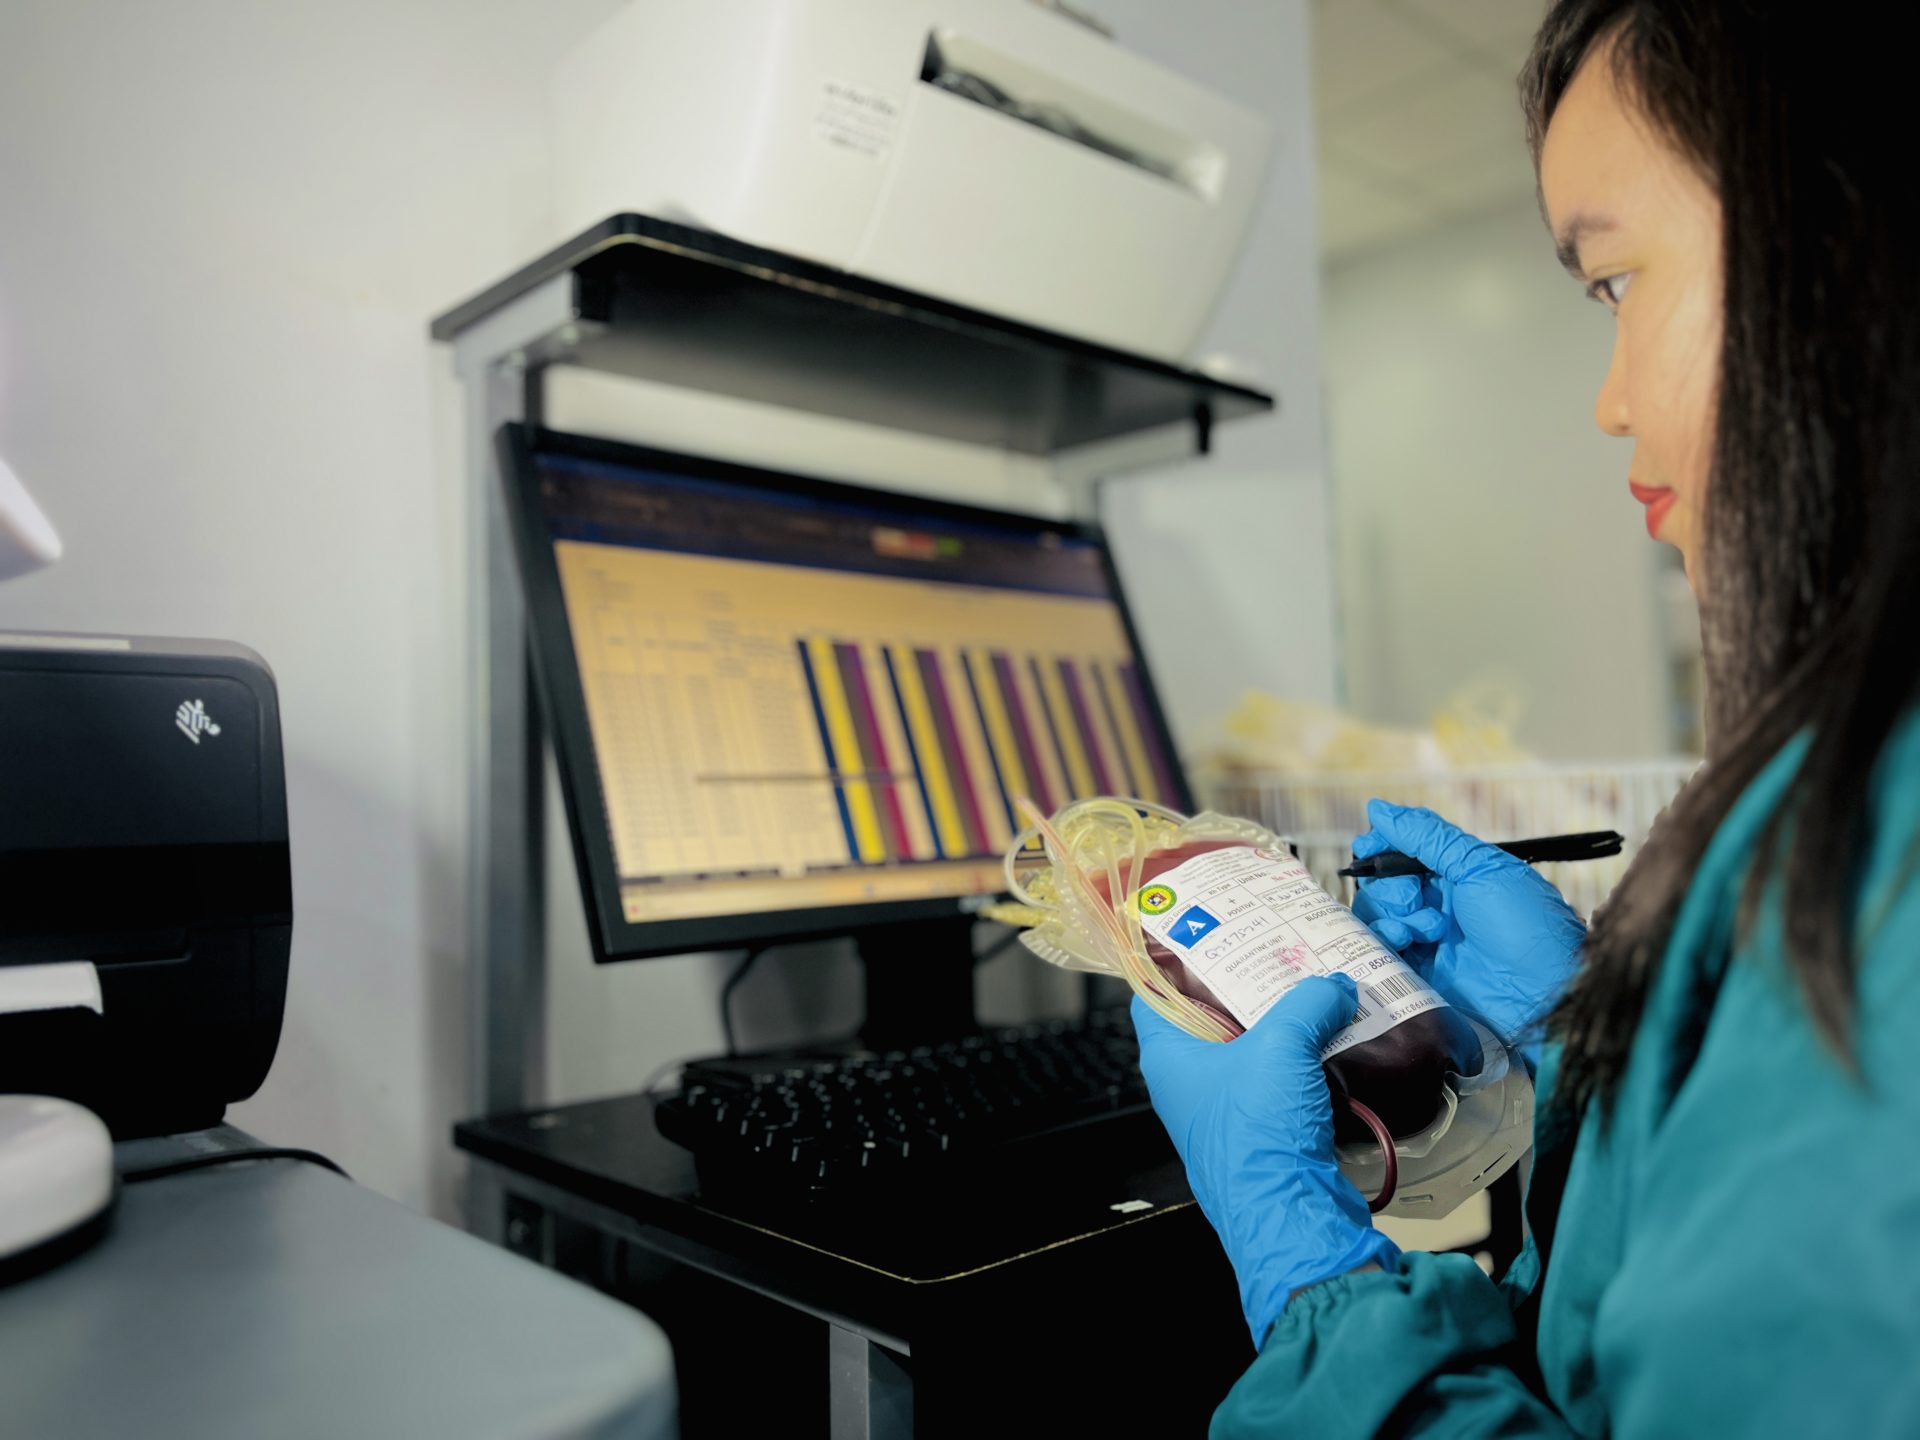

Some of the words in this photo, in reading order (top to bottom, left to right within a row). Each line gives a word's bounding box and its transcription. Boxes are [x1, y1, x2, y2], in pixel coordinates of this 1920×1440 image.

[1239, 874, 1254, 885] Unit
[1173, 903, 1192, 919] Group
[1226, 900, 1256, 918] POSITIVE
[1304, 910, 1328, 922] BLOOD
[1186, 919, 1207, 938] A
[1225, 942, 1269, 974] QUARANTINE
[1236, 966, 1251, 979] FOR
[1251, 963, 1280, 982] TESTING
